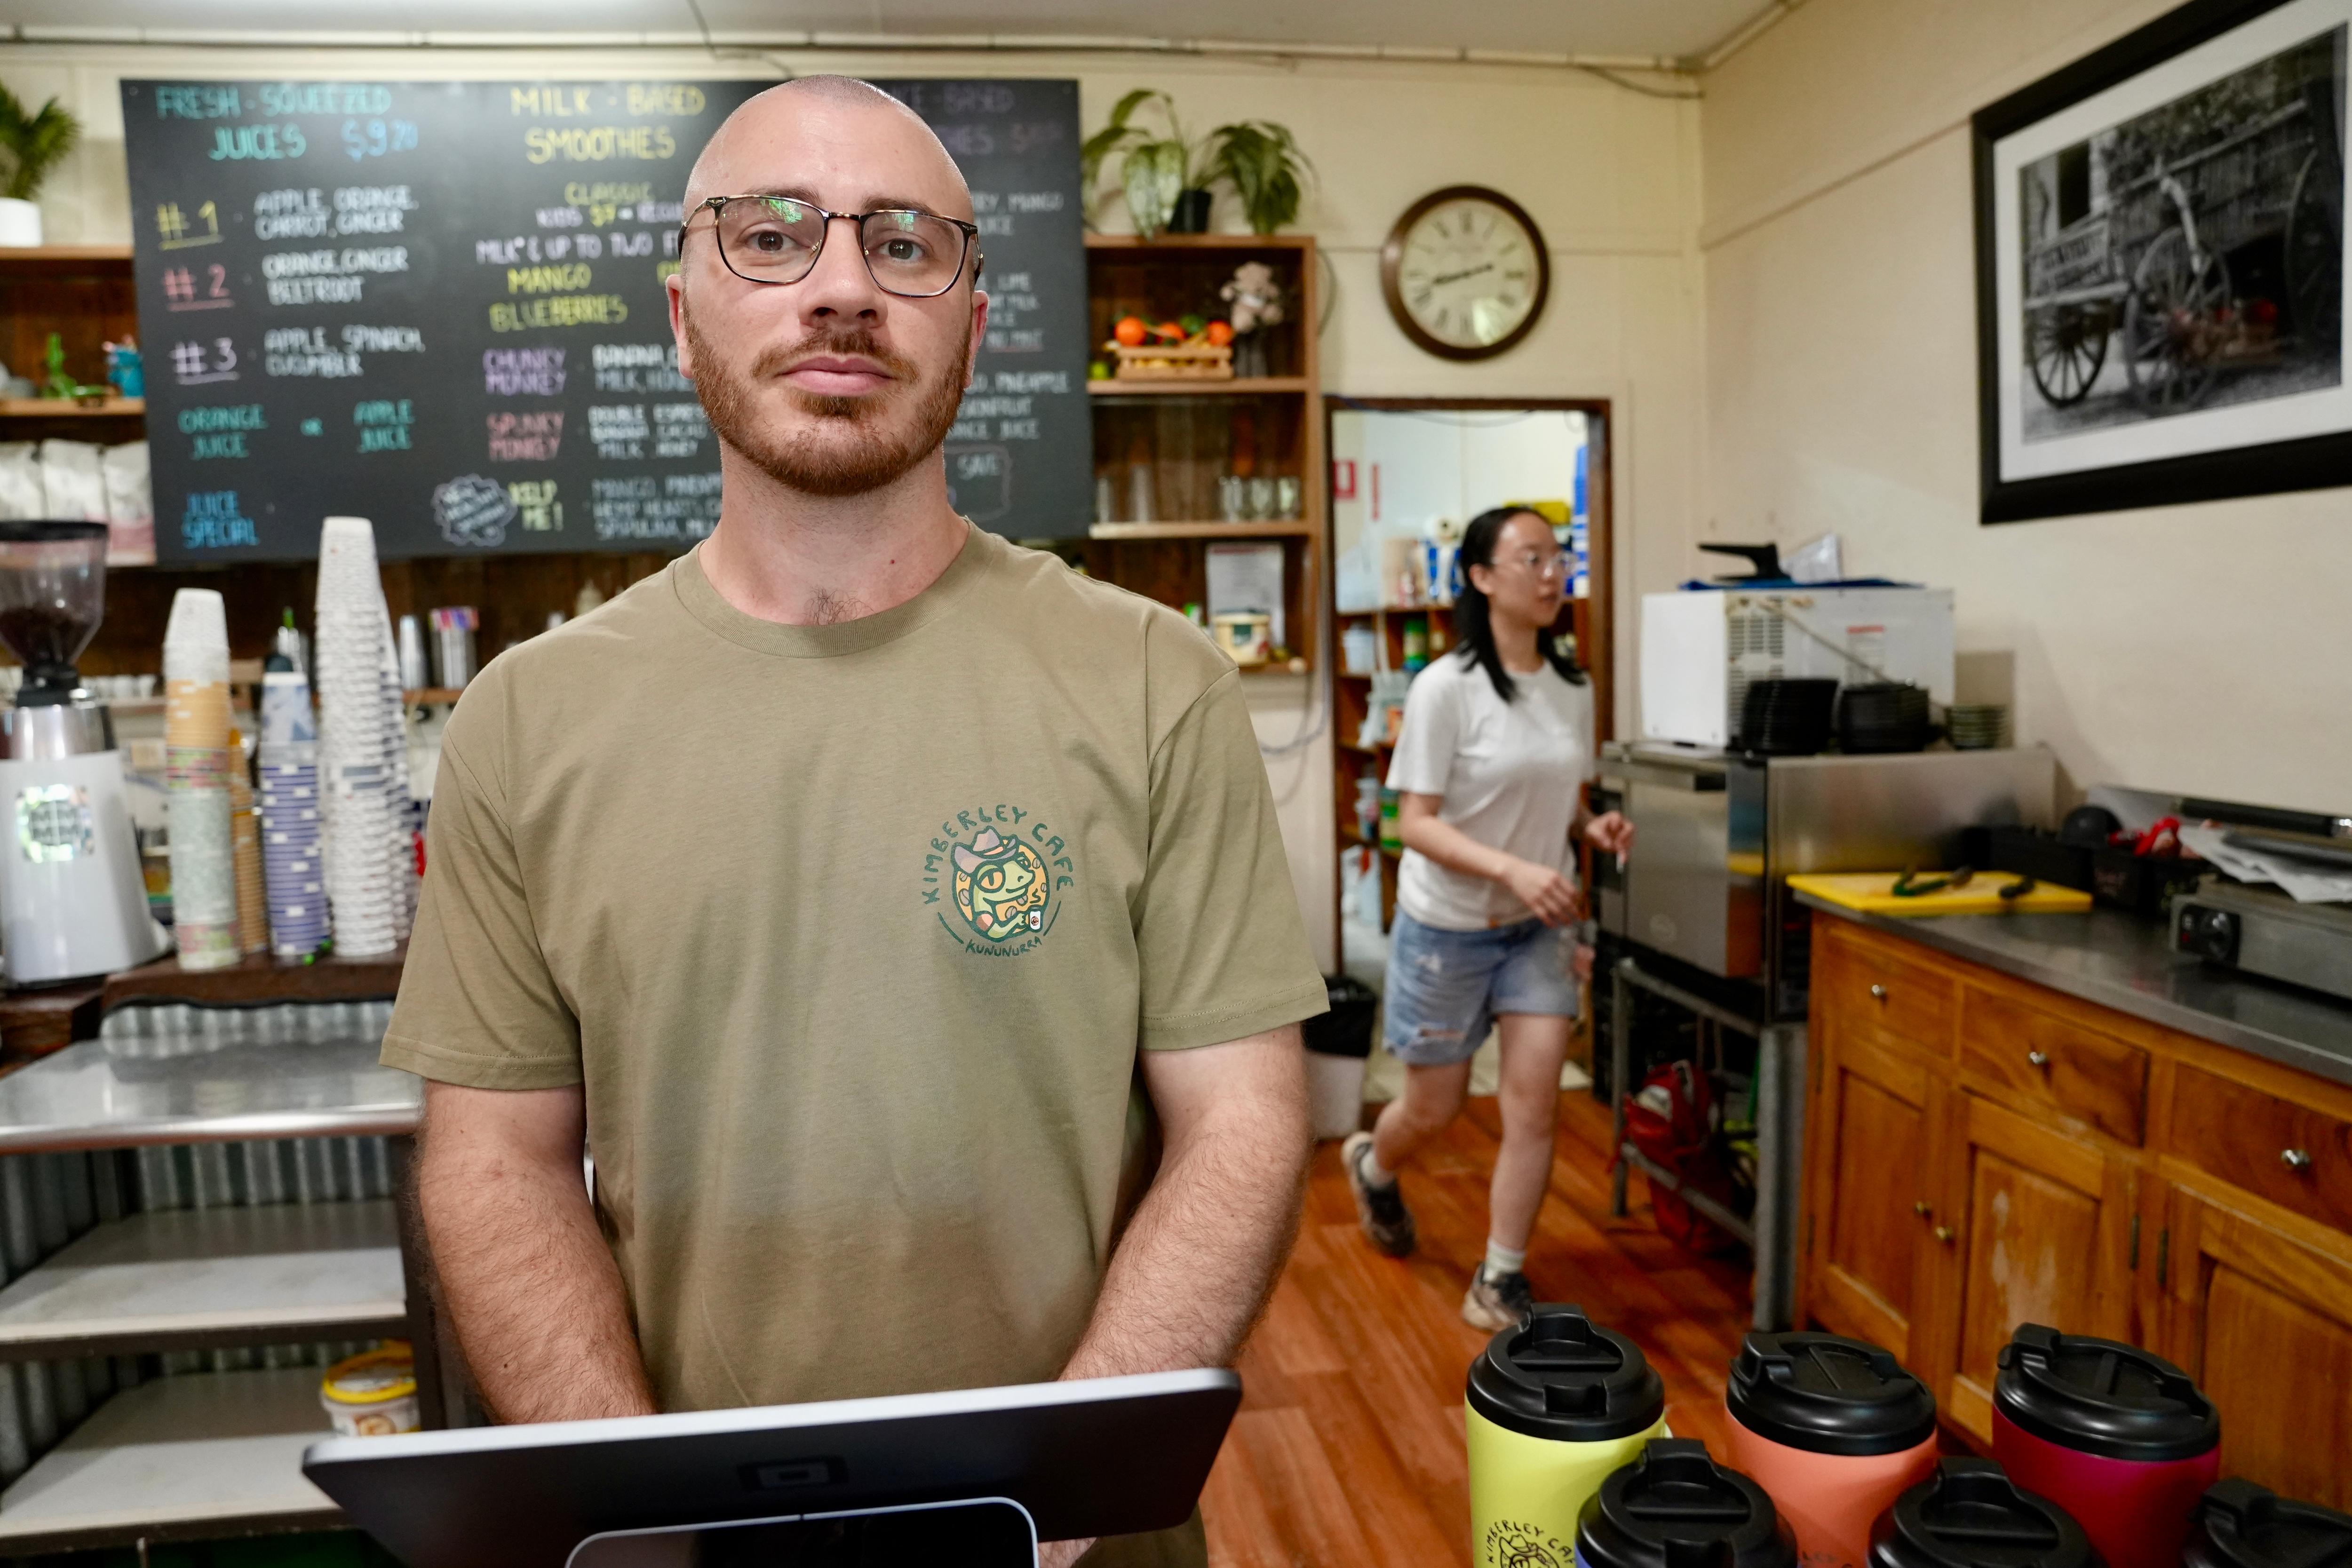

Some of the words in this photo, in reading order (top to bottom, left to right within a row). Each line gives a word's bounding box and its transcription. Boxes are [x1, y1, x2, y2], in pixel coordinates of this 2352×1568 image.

[155, 86, 241, 119] FRESH
[510, 86, 591, 117] MILK
[627, 84, 705, 116] BASED
[208, 123, 307, 160] JUICES
[545, 235, 571, 260] UP
[576, 234, 602, 259] TO
[609, 231, 653, 257] TWO
[507, 263, 591, 294] MANGO
[178, 404, 267, 433] ORANGE
[193, 431, 249, 460] JUICE
[922, 804, 1027, 904] KIMBERLEY
[1032, 823, 1073, 891] CAFE
[965, 936, 1042, 957] KUNUNURRA
[1487, 1520, 1544, 1563] KIMBERLEY
[1548, 1538, 1575, 1563] CAF
